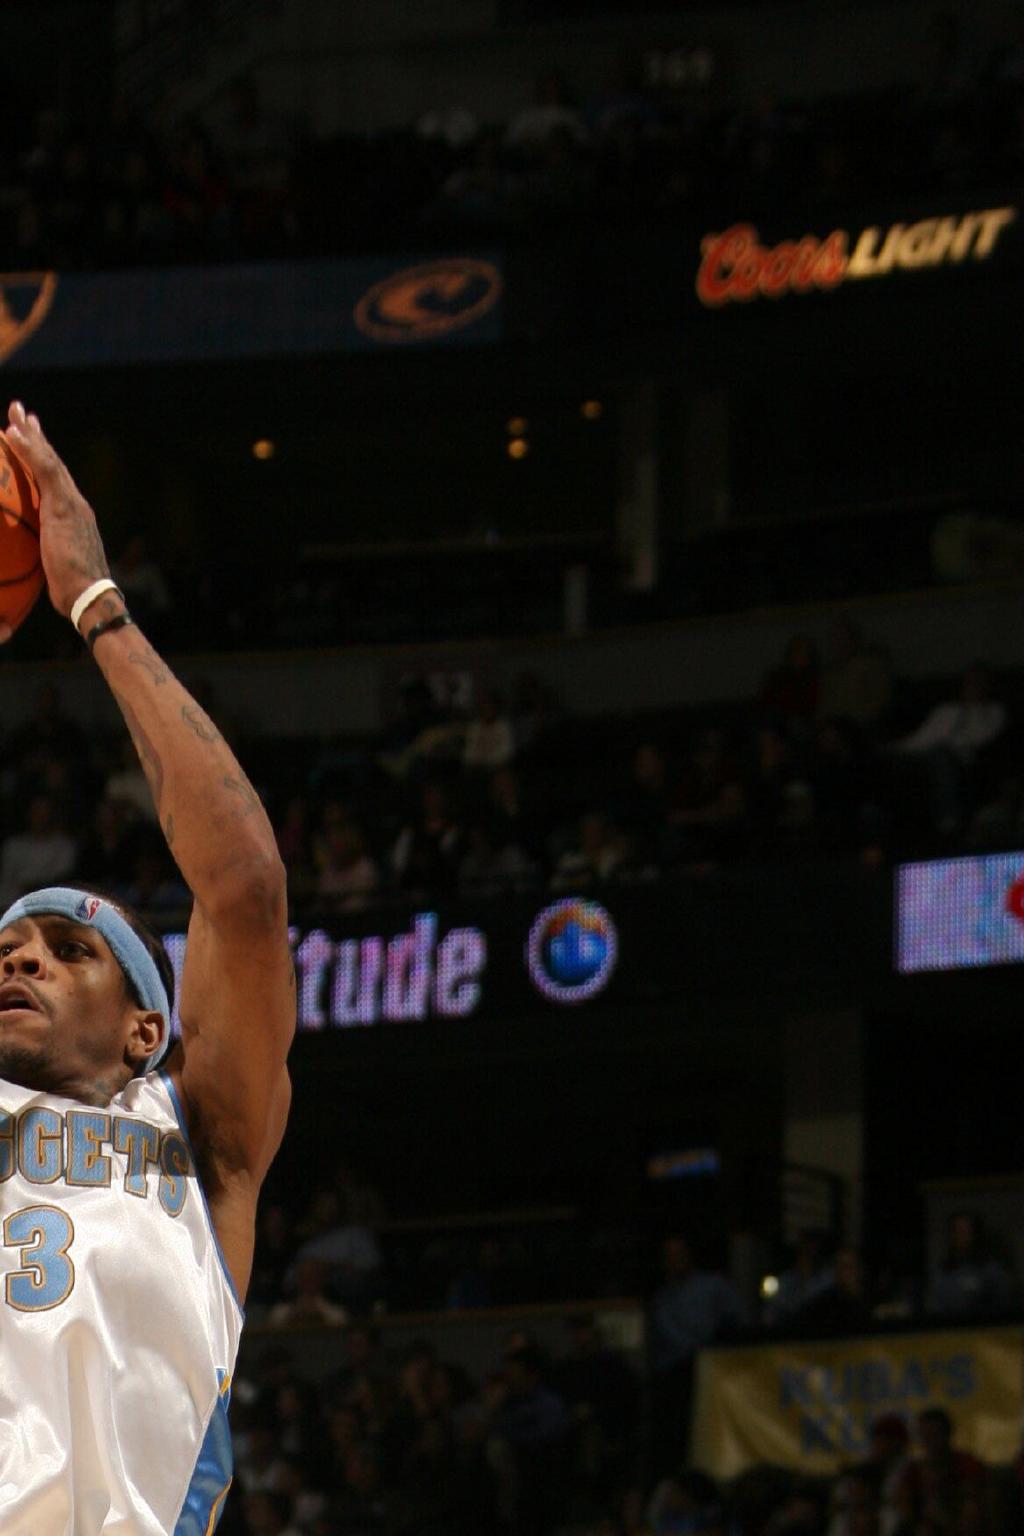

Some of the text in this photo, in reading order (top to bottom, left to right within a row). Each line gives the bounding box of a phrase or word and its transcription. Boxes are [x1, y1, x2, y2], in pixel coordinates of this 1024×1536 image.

[696, 206, 1015, 308] Coors LIGHT
[288, 911, 488, 1031] tude
[2, 1204, 75, 1313] 3
